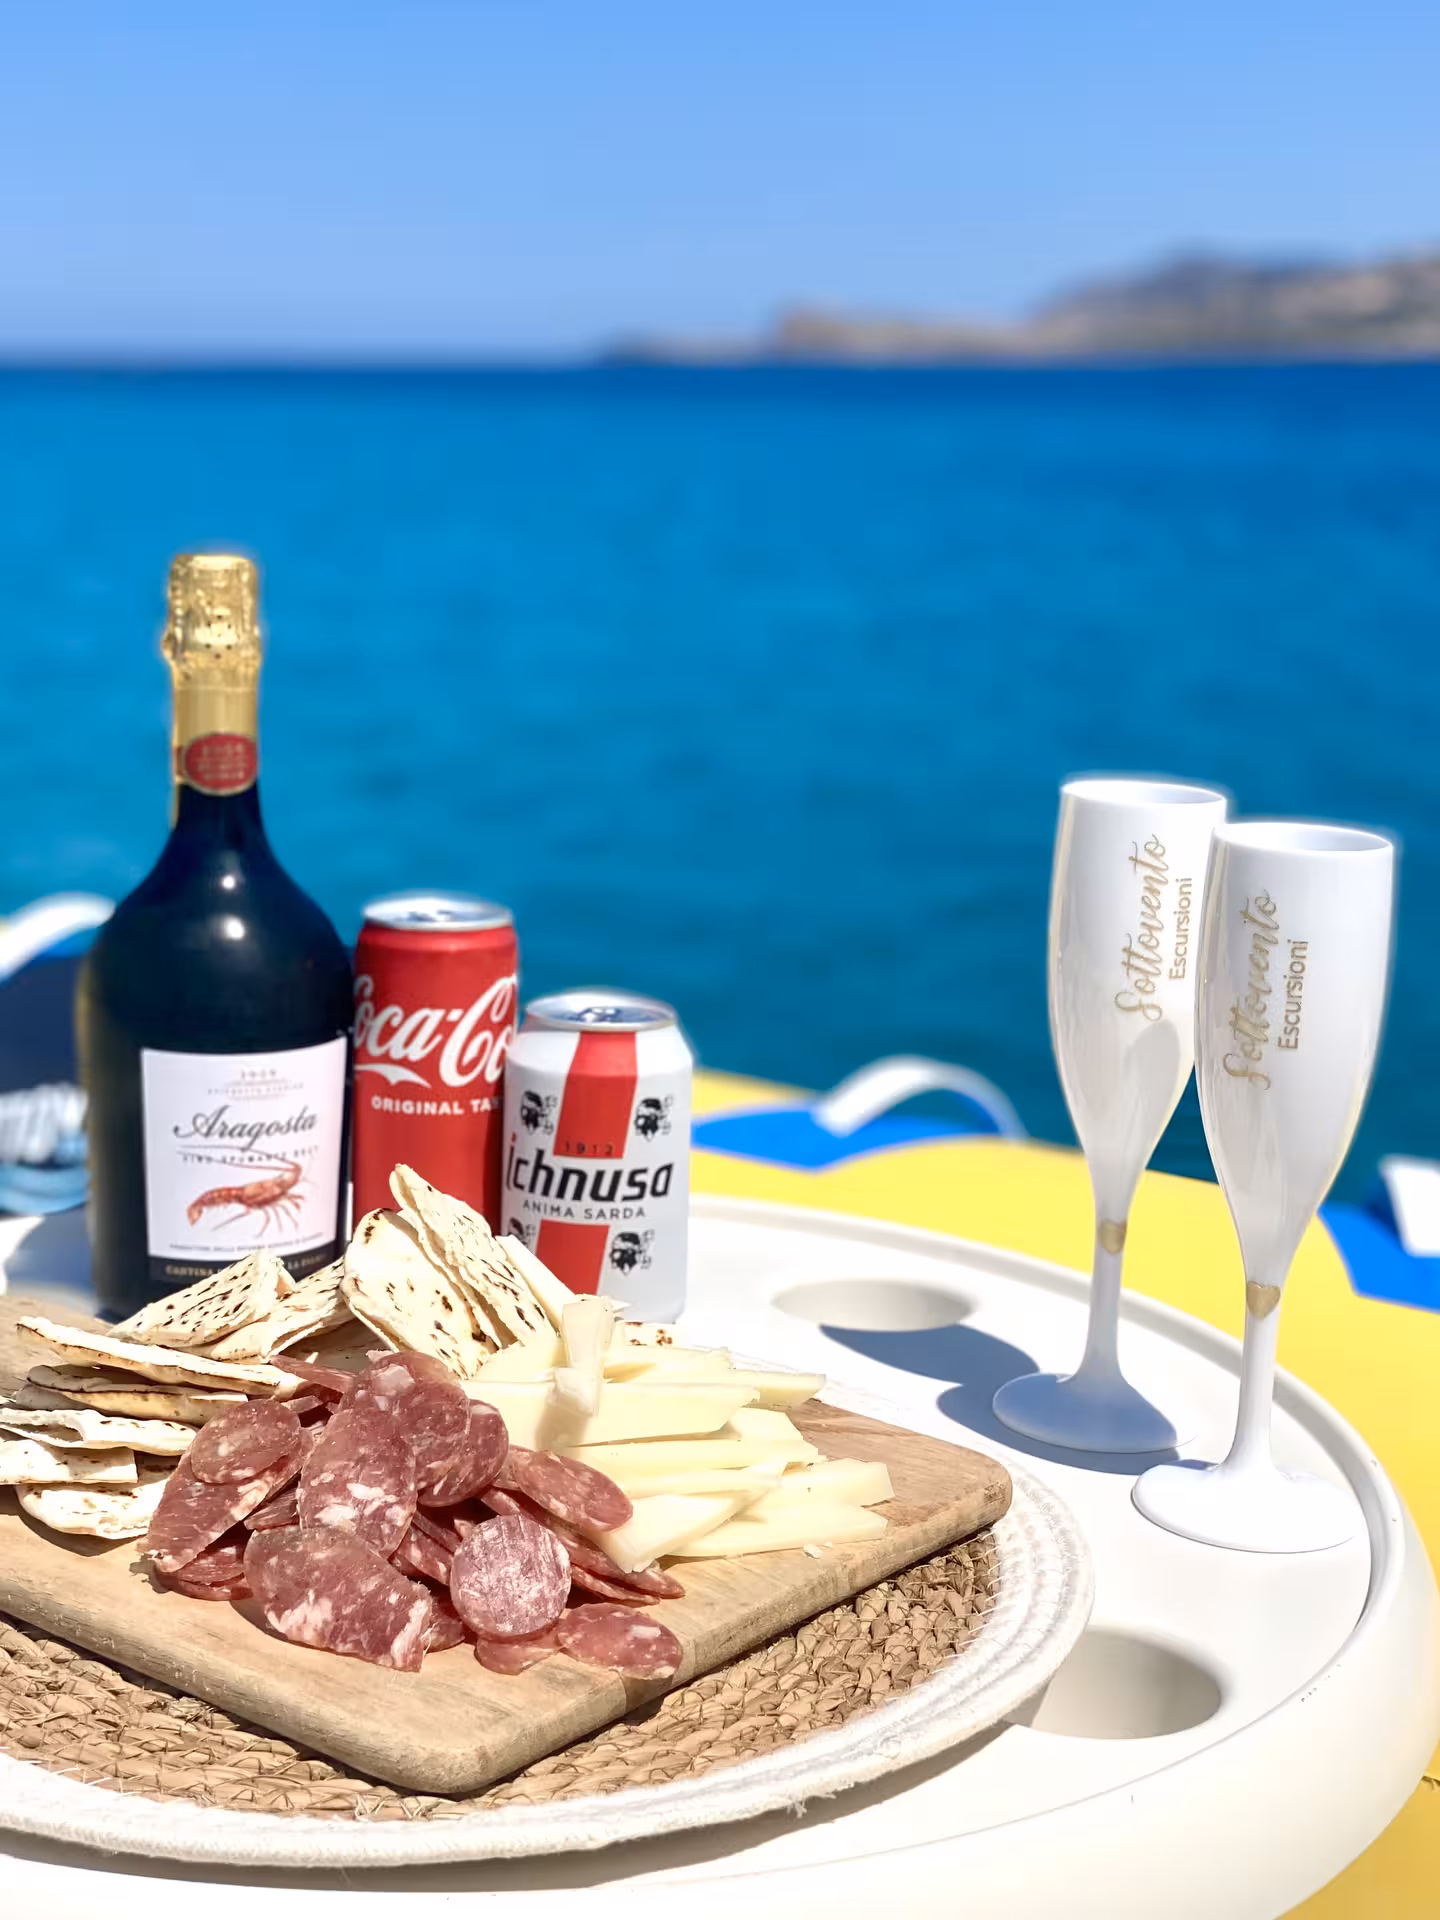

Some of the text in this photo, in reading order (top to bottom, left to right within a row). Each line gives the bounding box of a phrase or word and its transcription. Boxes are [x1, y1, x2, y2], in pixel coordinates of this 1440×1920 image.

[1114, 833, 1169, 1021] Sottovento
[1168, 877, 1192, 980] Escursioni
[1278, 939, 1309, 1049] Escursioni
[173, 1104, 318, 1152] Aragosta
[371, 1096, 465, 1115] ORIGINAL
[565, 1139, 614, 1155] 1912
[523, 1200, 646, 1220] ANIMA SARDA
